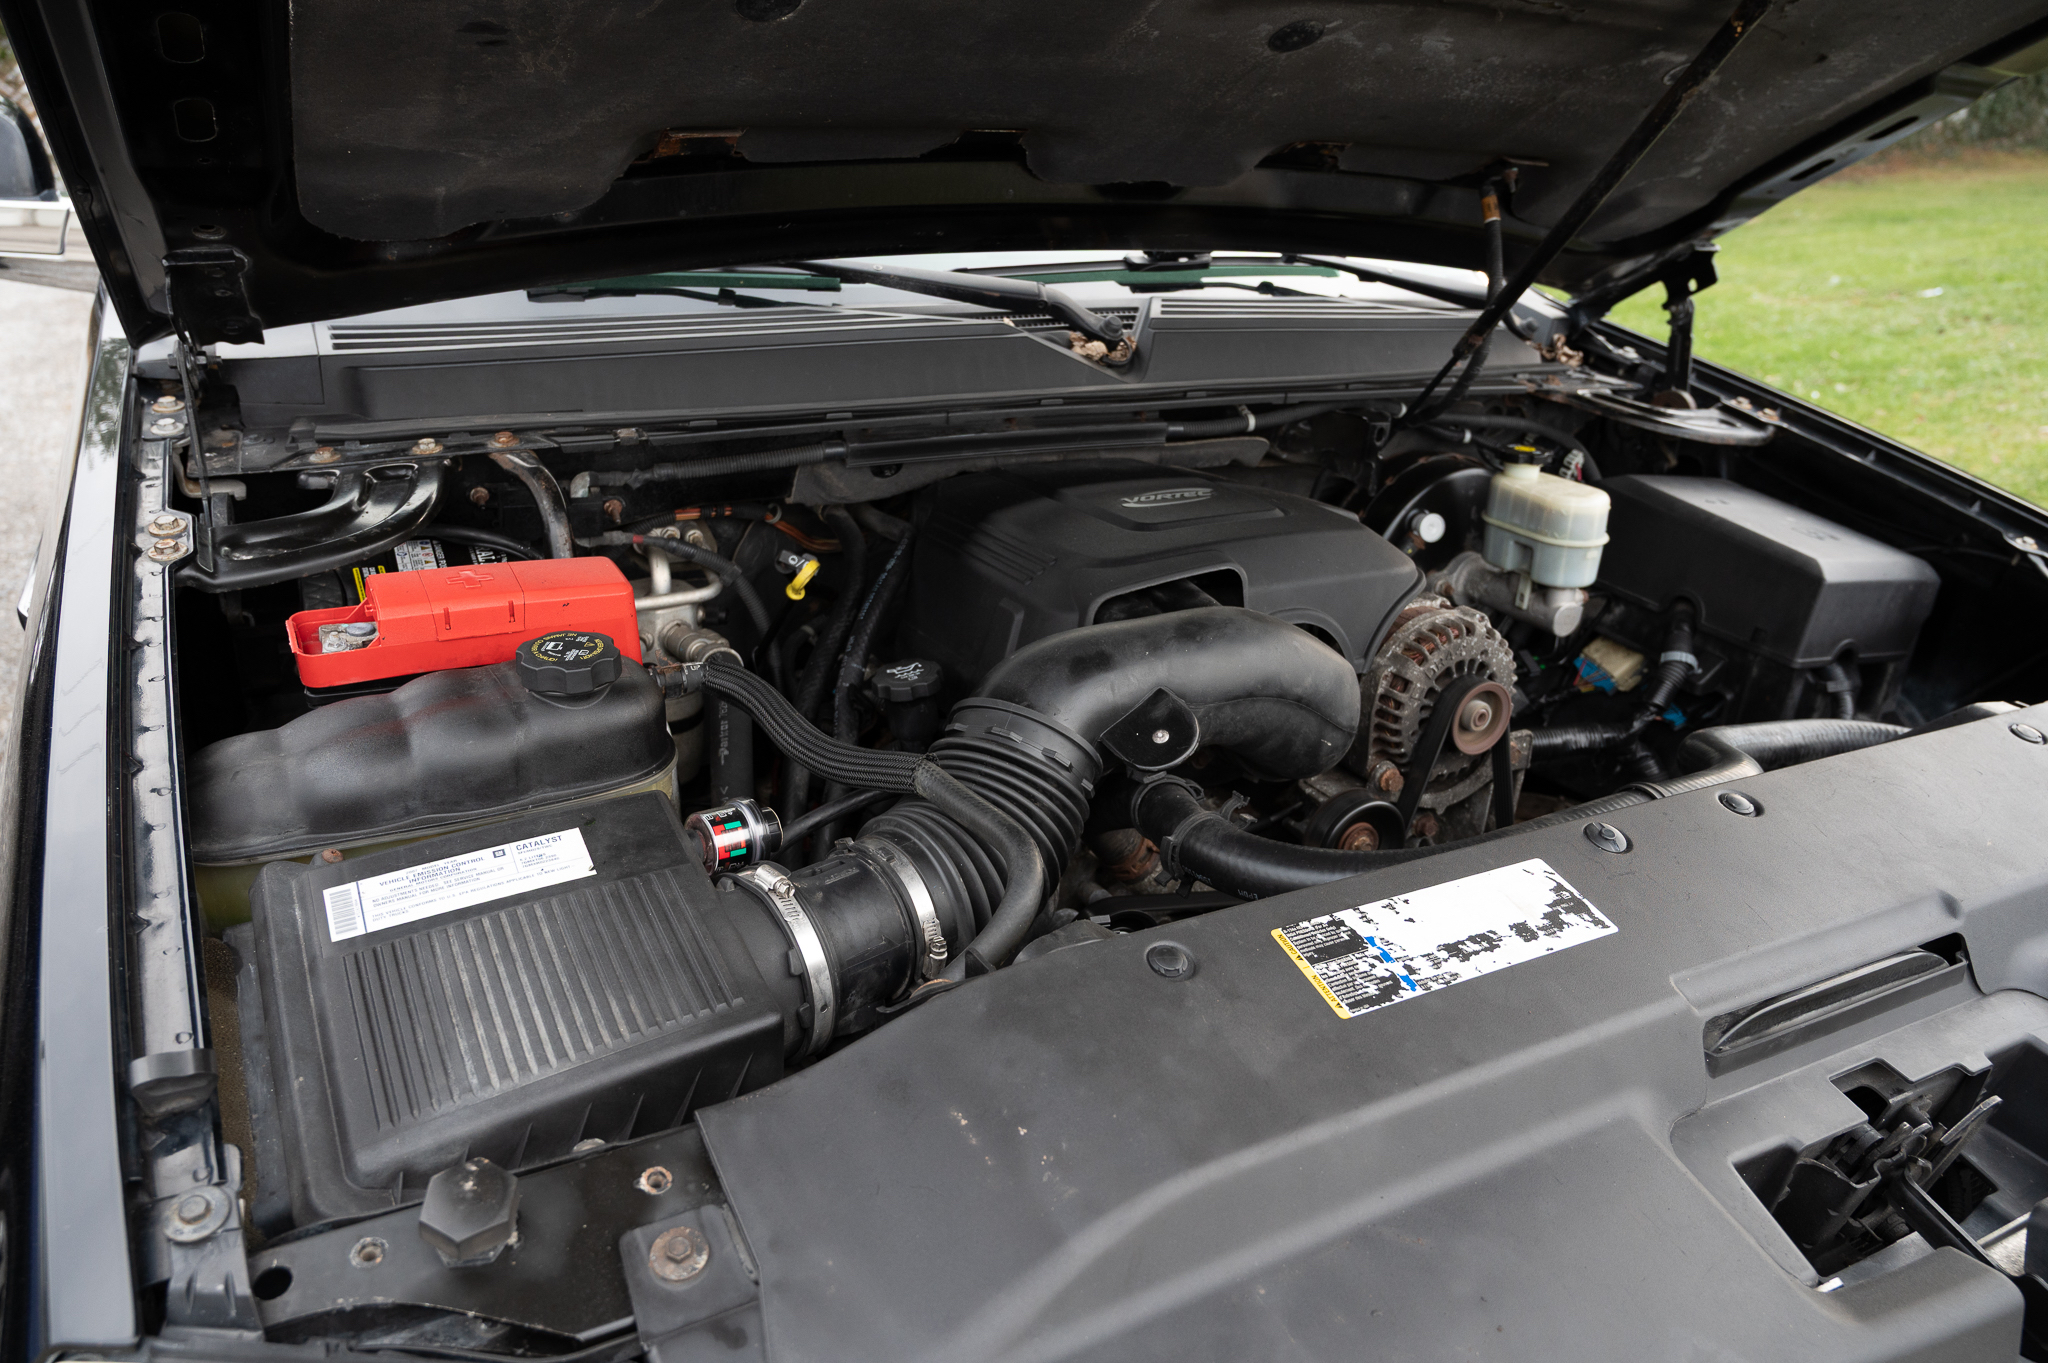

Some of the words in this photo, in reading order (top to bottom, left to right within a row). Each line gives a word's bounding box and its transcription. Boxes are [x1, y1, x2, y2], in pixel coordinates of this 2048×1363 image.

[1120, 488, 1213, 503] VORTEC
[515, 835, 563, 851] CATALYST
[380, 876, 409, 886] VEHICLE
[413, 866, 449, 878] EMISSION
[451, 857, 484, 868] CONTROL
[409, 867, 461, 883] INFORMATION
[1278, 934, 1298, 955] CAUTION
[1311, 974, 1338, 1002] ATTENTION
